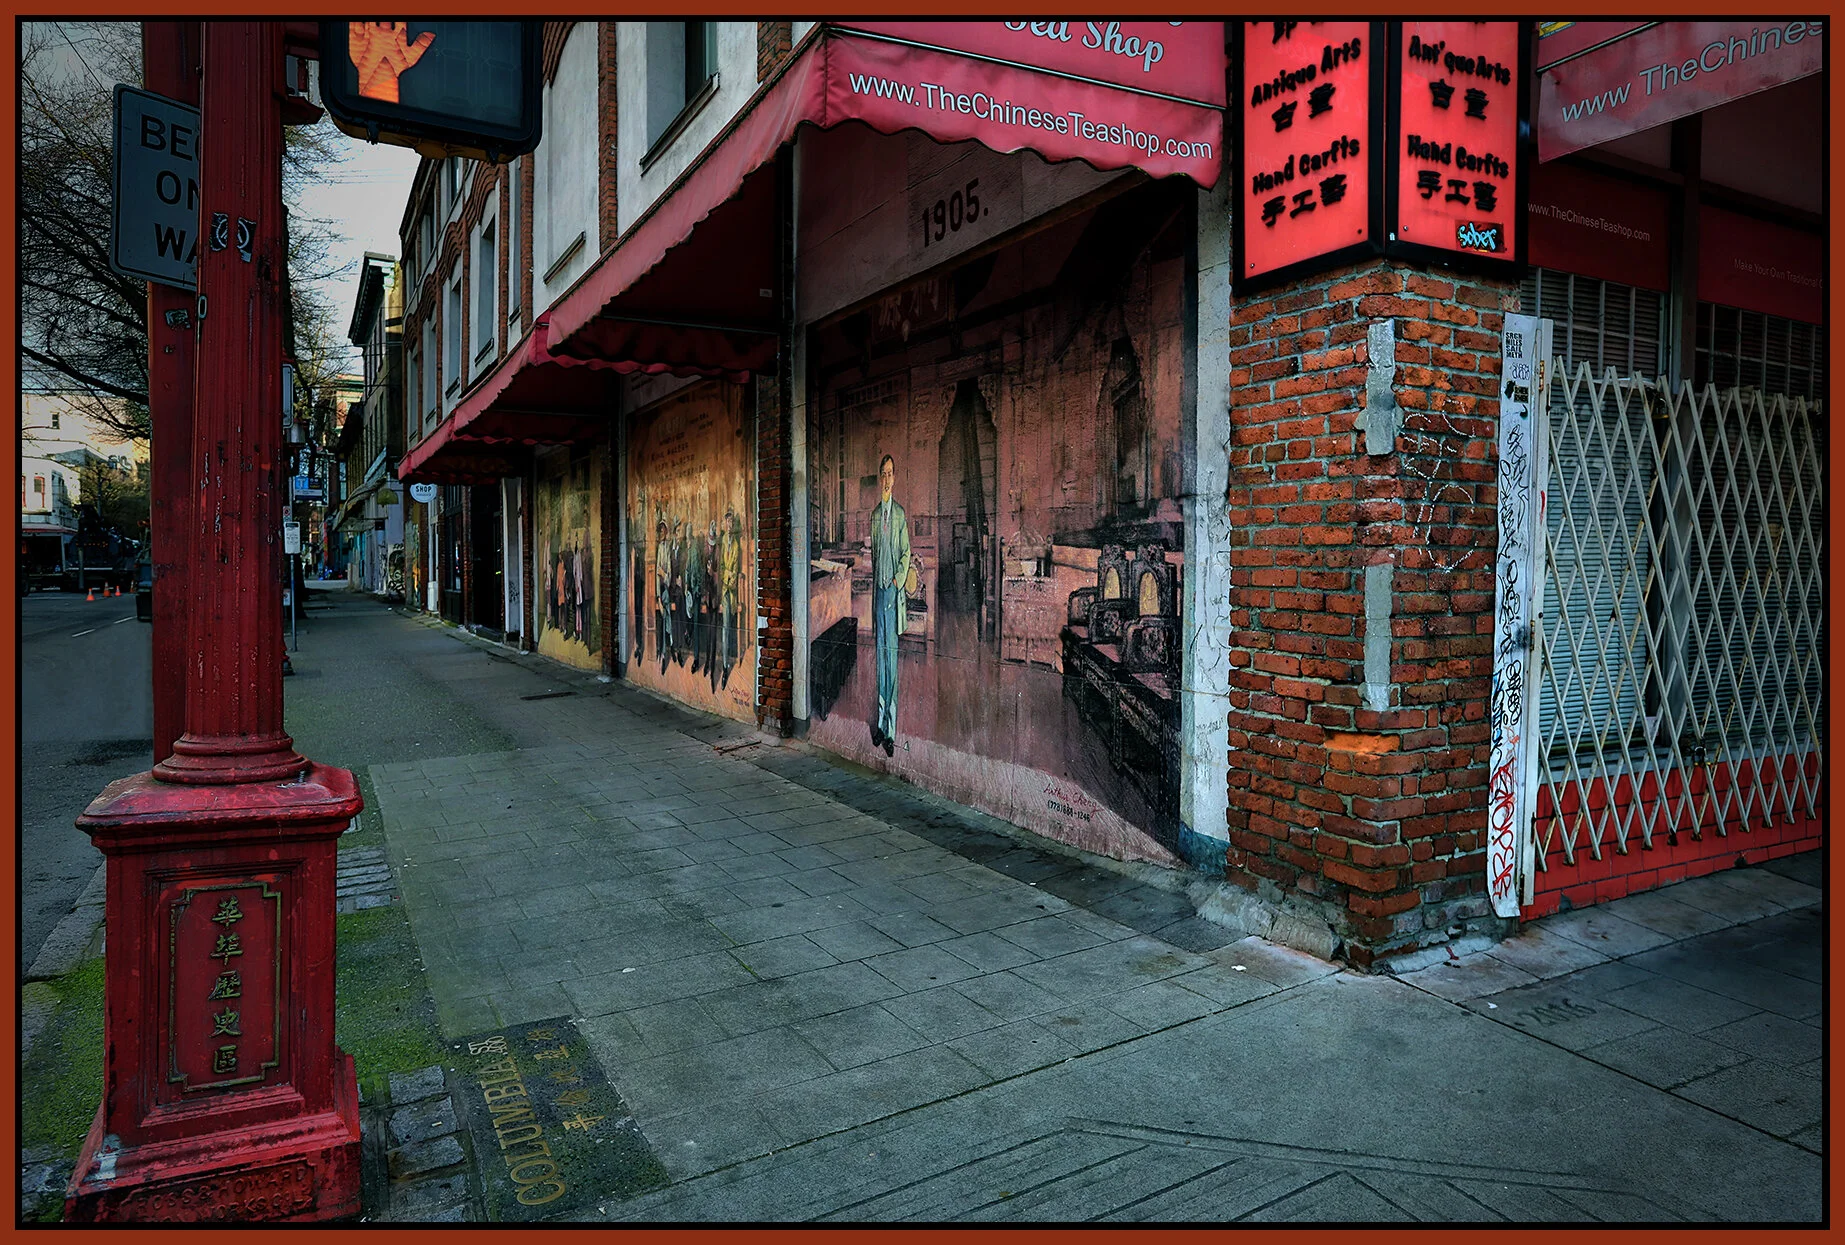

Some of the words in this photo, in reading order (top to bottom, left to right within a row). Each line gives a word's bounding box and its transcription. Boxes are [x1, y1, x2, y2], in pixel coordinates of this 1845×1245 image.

[1082, 22, 1165, 72] Shop
[1251, 64, 1316, 108] Antique
[141, 112, 199, 162] BE
[848, 73, 1213, 159] www.TheChineseTeashop.com
[1253, 154, 1294, 195] Hand
[1407, 134, 1452, 165] Hand
[923, 177, 989, 248] 1905.
[1528, 202, 1651, 242] www.TheChineseTeashop.com
[415, 485, 432, 493] SHOP
[208, 896, 243, 1074] 華埠歷史區
[477, 1056, 566, 1206] COLUMBIA
